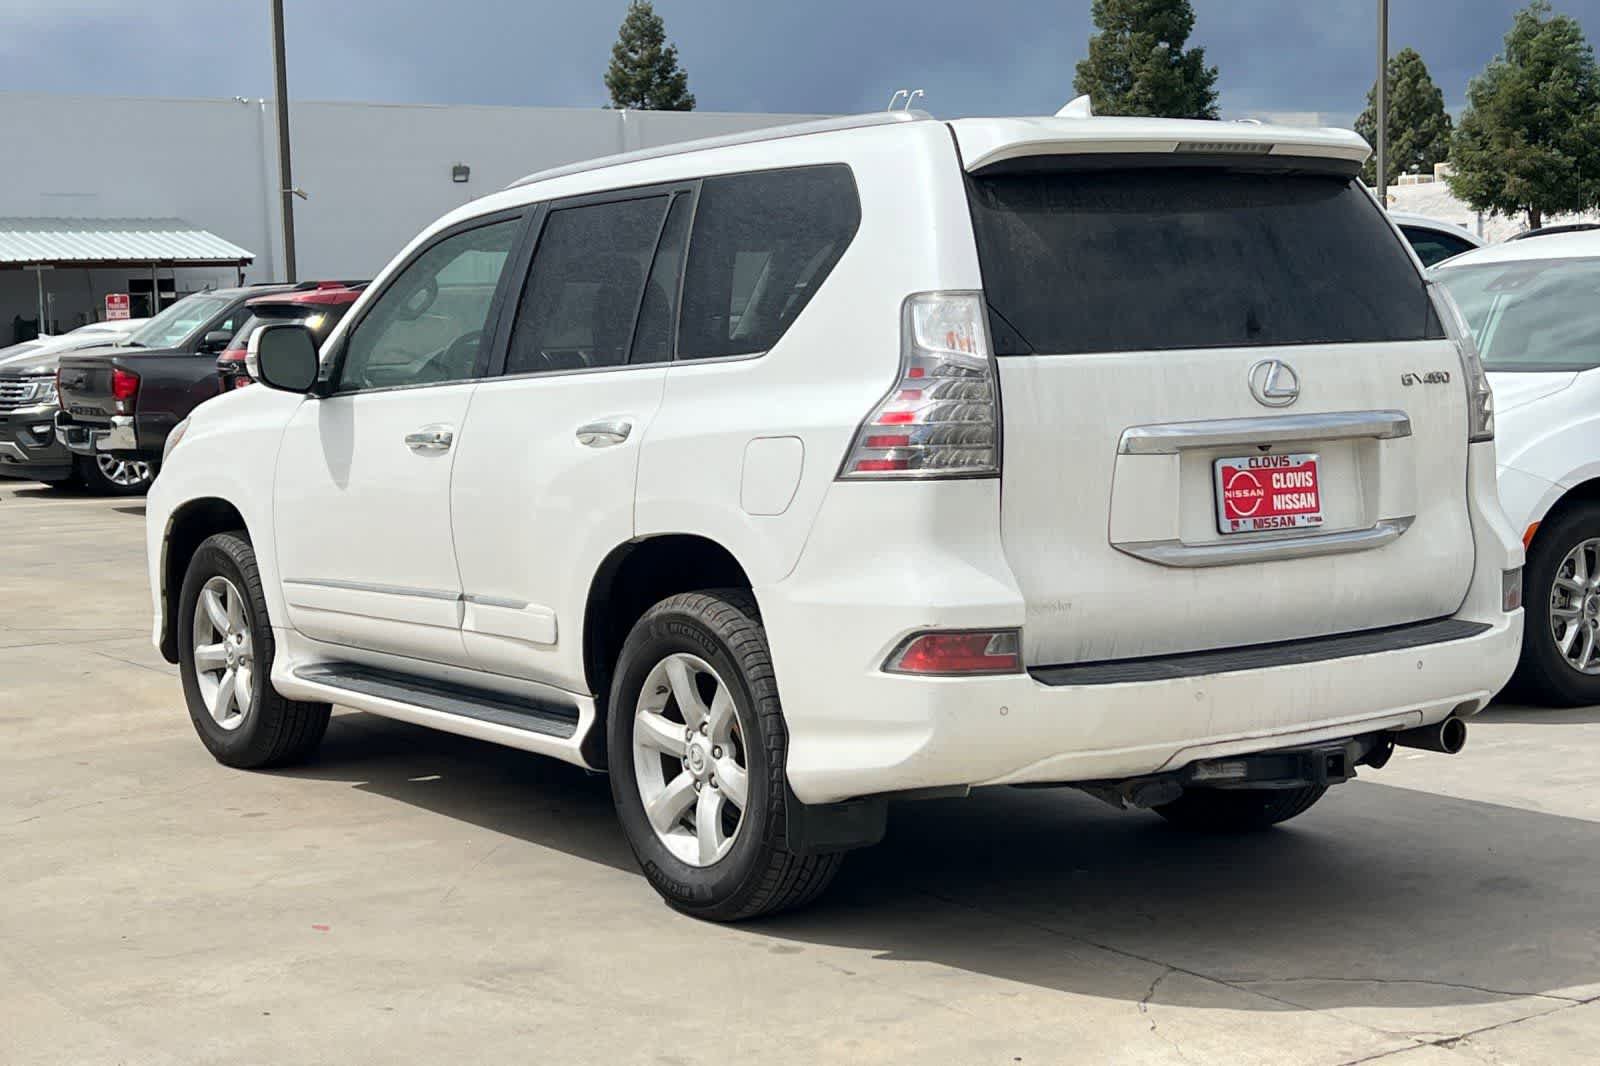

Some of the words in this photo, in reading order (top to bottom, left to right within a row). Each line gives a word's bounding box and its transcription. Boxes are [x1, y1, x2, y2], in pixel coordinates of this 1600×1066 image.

[1249, 456, 1290, 469] CLOVIS
[1272, 472, 1313, 489] CLOVIS
[1224, 488, 1264, 498] NISSAN
[1273, 492, 1316, 511] NISSAN
[1253, 516, 1296, 529] NISSAN
